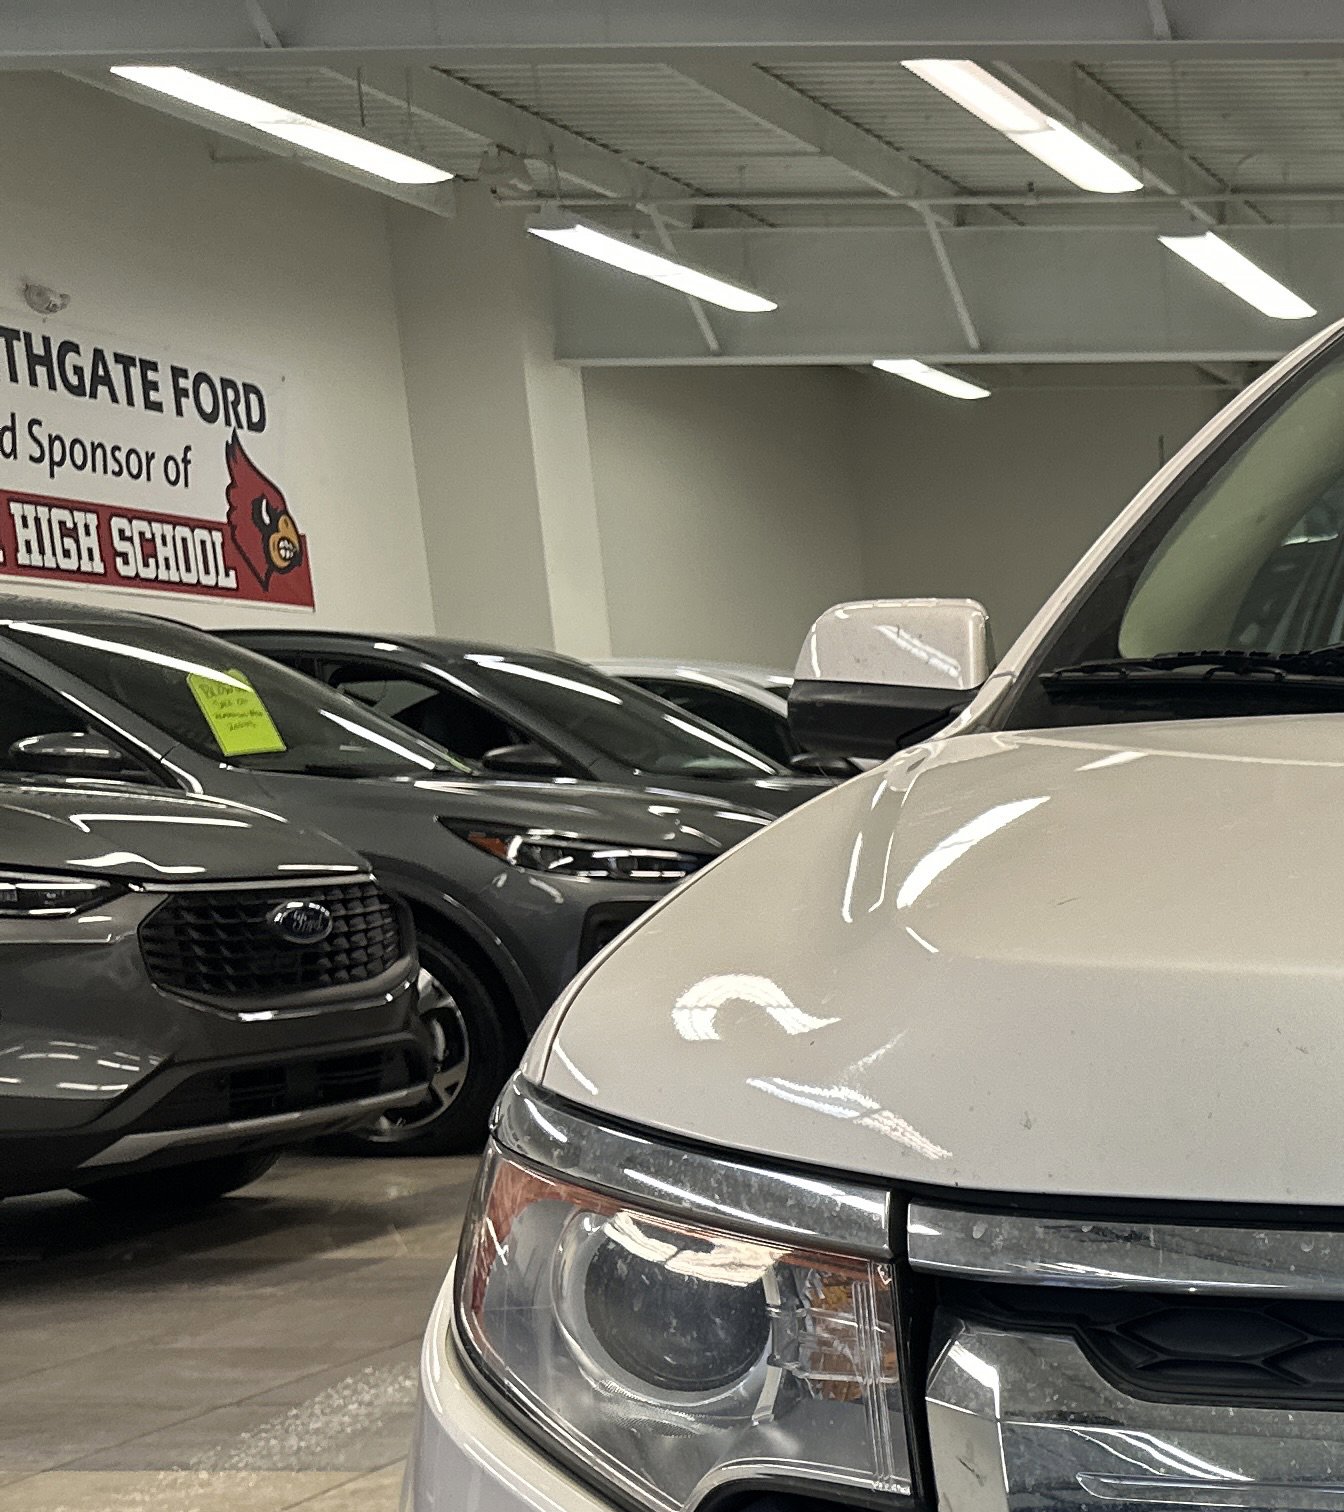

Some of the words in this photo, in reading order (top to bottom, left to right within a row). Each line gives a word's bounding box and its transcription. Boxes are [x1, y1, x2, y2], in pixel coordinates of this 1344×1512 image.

[169, 364, 267, 434] FORD
[27, 417, 156, 483] Sponsor
[163, 445, 193, 489] of
[9, 500, 105, 575] HIGH
[109, 515, 238, 589] SCHOOL
